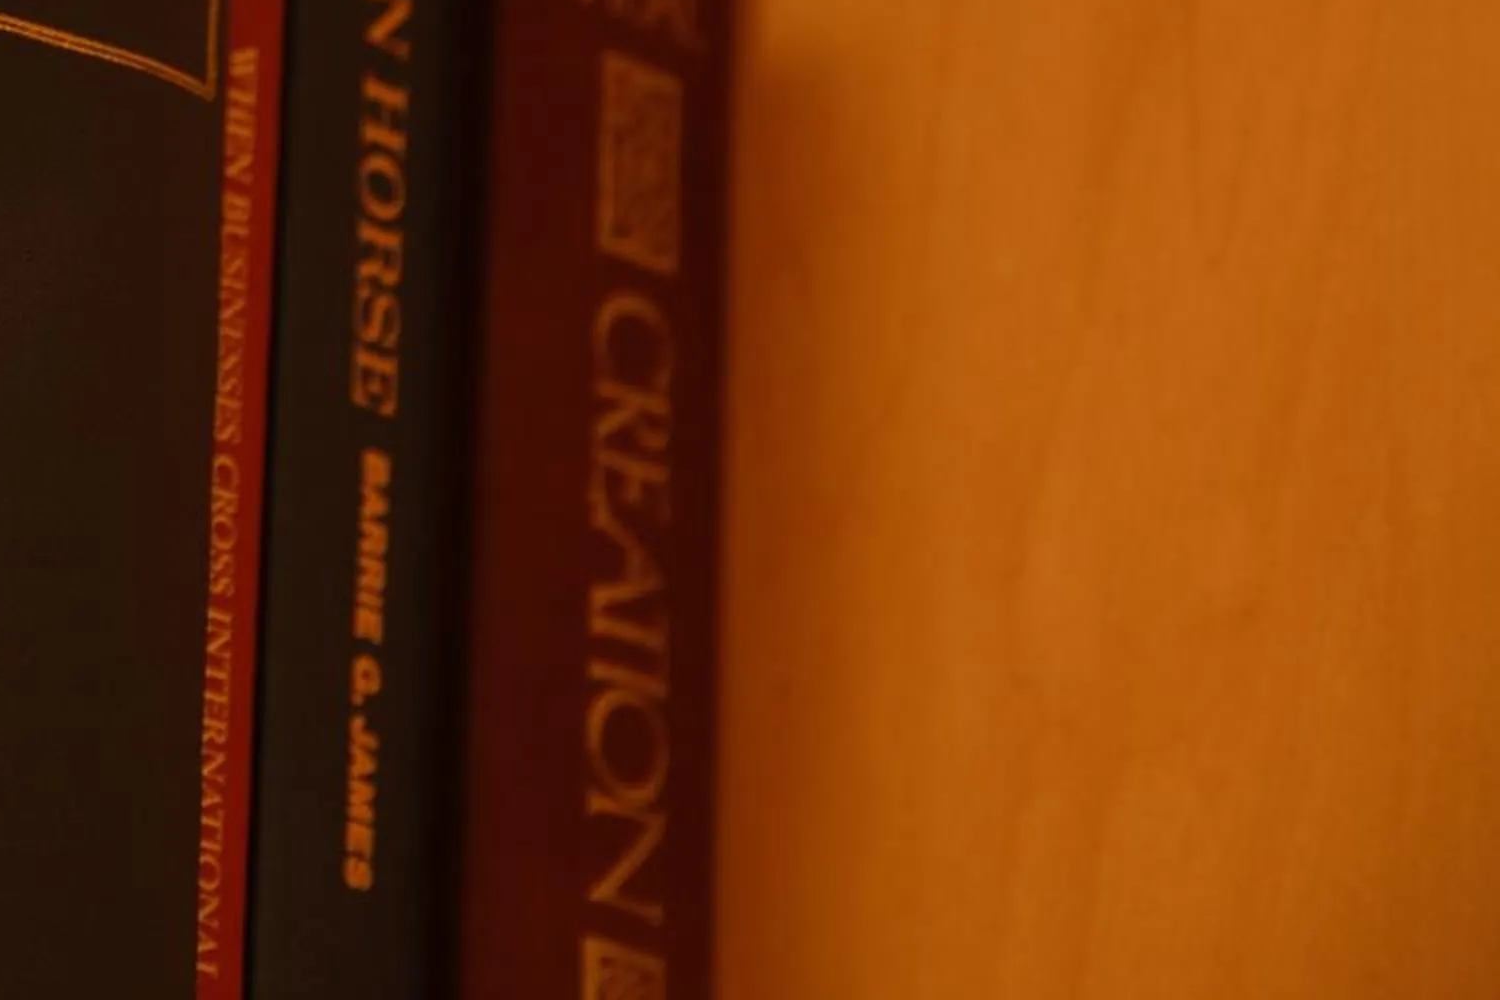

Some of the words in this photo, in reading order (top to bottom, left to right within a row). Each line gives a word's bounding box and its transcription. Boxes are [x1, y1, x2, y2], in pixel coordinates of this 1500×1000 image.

[223, 47, 259, 184] WHEN
[212, 193, 252, 445] BUSINESSES
[349, 70, 409, 417] HORSE
[207, 454, 240, 598] CROSS
[354, 448, 392, 644] BARRIE
[586, 291, 674, 927] CREATION
[343, 713, 380, 891] JAMES
